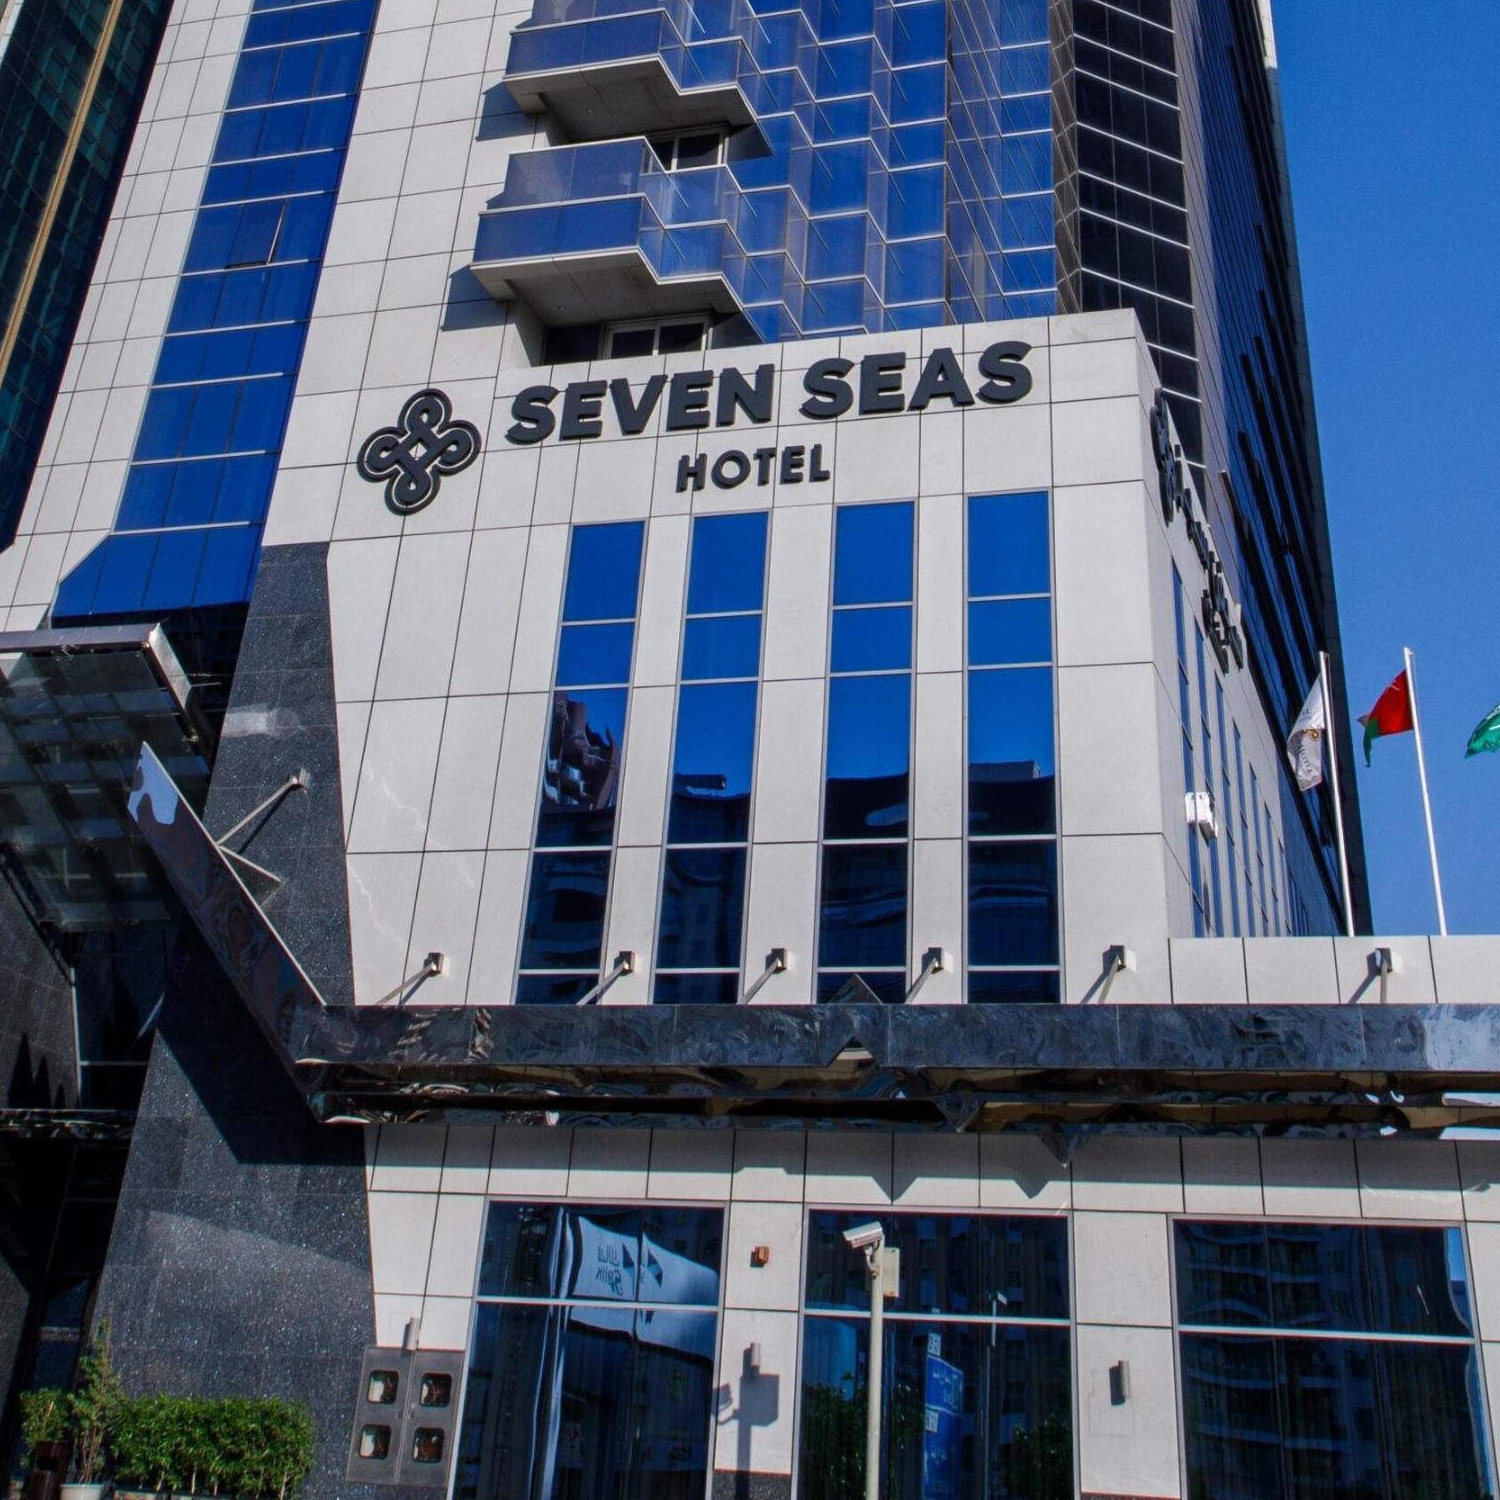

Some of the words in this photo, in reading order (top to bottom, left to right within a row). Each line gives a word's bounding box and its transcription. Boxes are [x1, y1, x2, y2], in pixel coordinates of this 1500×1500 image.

[504, 363, 775, 444] SEVEN
[800, 340, 1034, 420] SEAS
[677, 444, 831, 494] HOTEL
